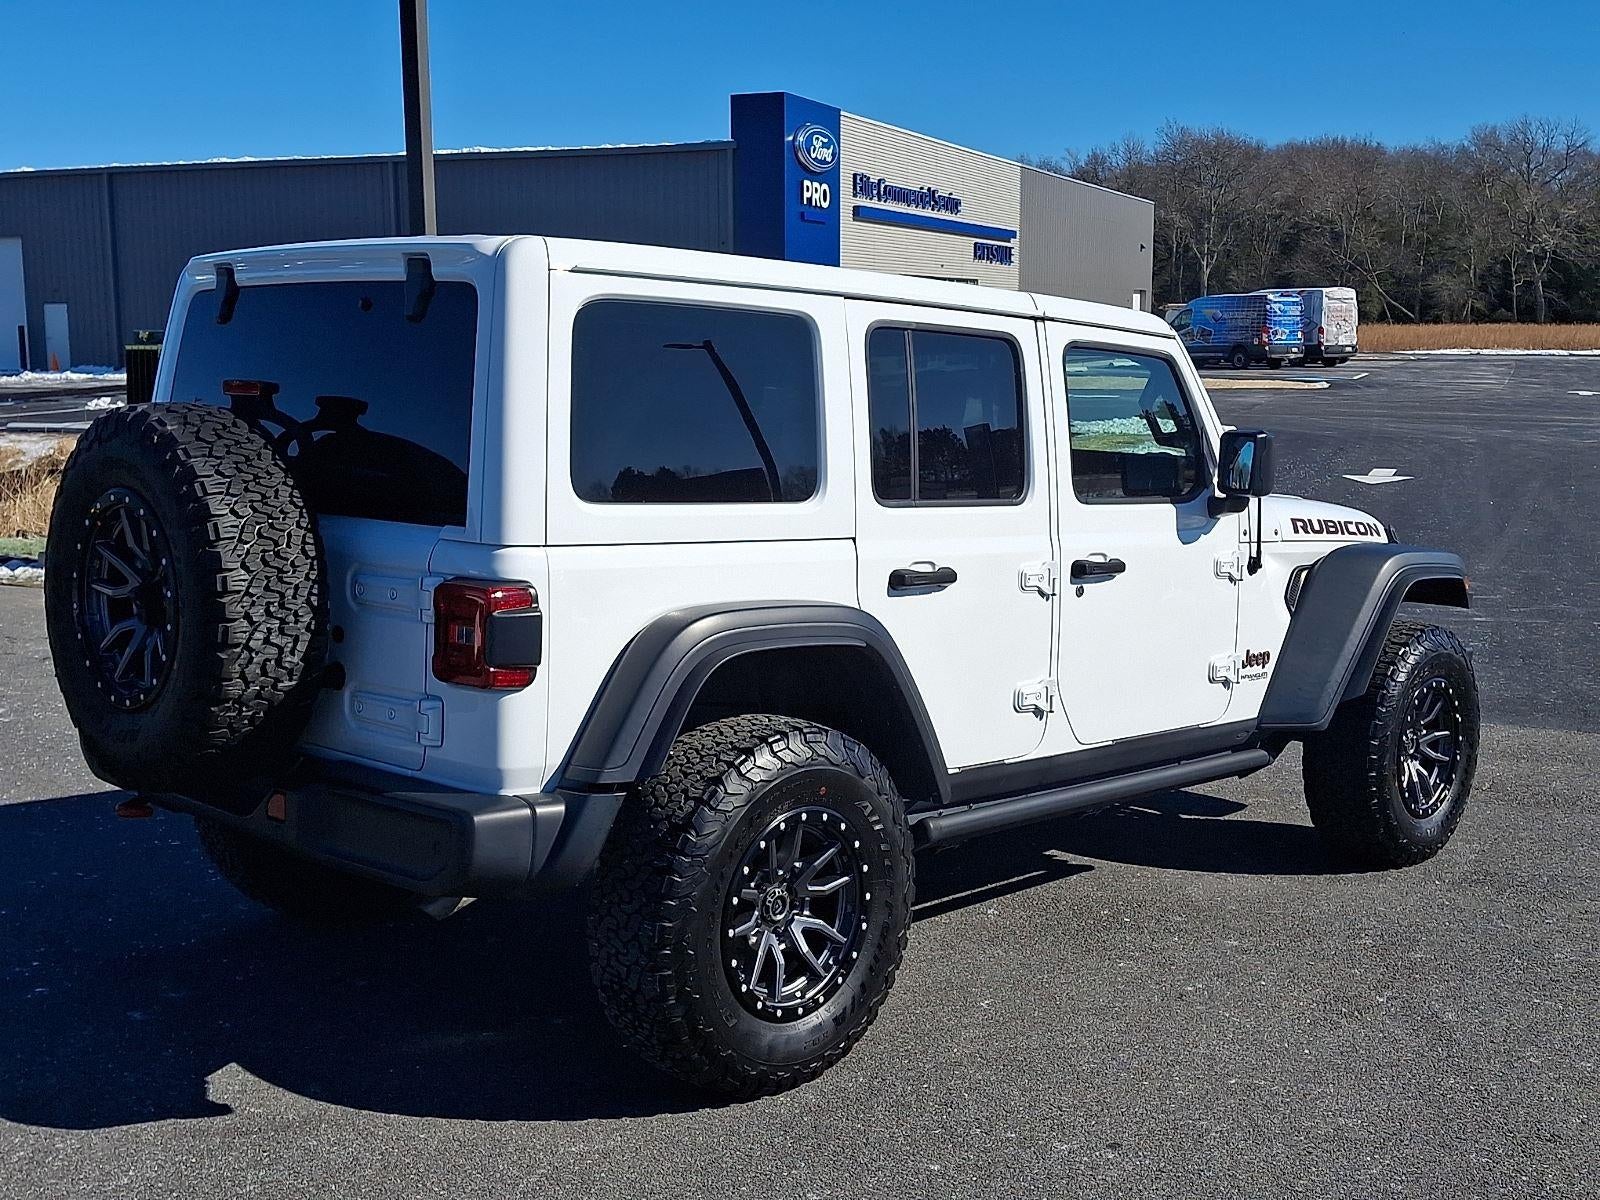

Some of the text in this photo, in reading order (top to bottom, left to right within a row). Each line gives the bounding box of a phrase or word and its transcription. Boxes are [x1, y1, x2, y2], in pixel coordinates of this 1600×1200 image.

[810, 134, 834, 162] Ford
[803, 179, 830, 209] PRO
[852, 172, 878, 201] Elite
[876, 178, 932, 209] Commercial
[1290, 517, 1382, 537] RUBICON
[1241, 649, 1271, 670] Jeep
